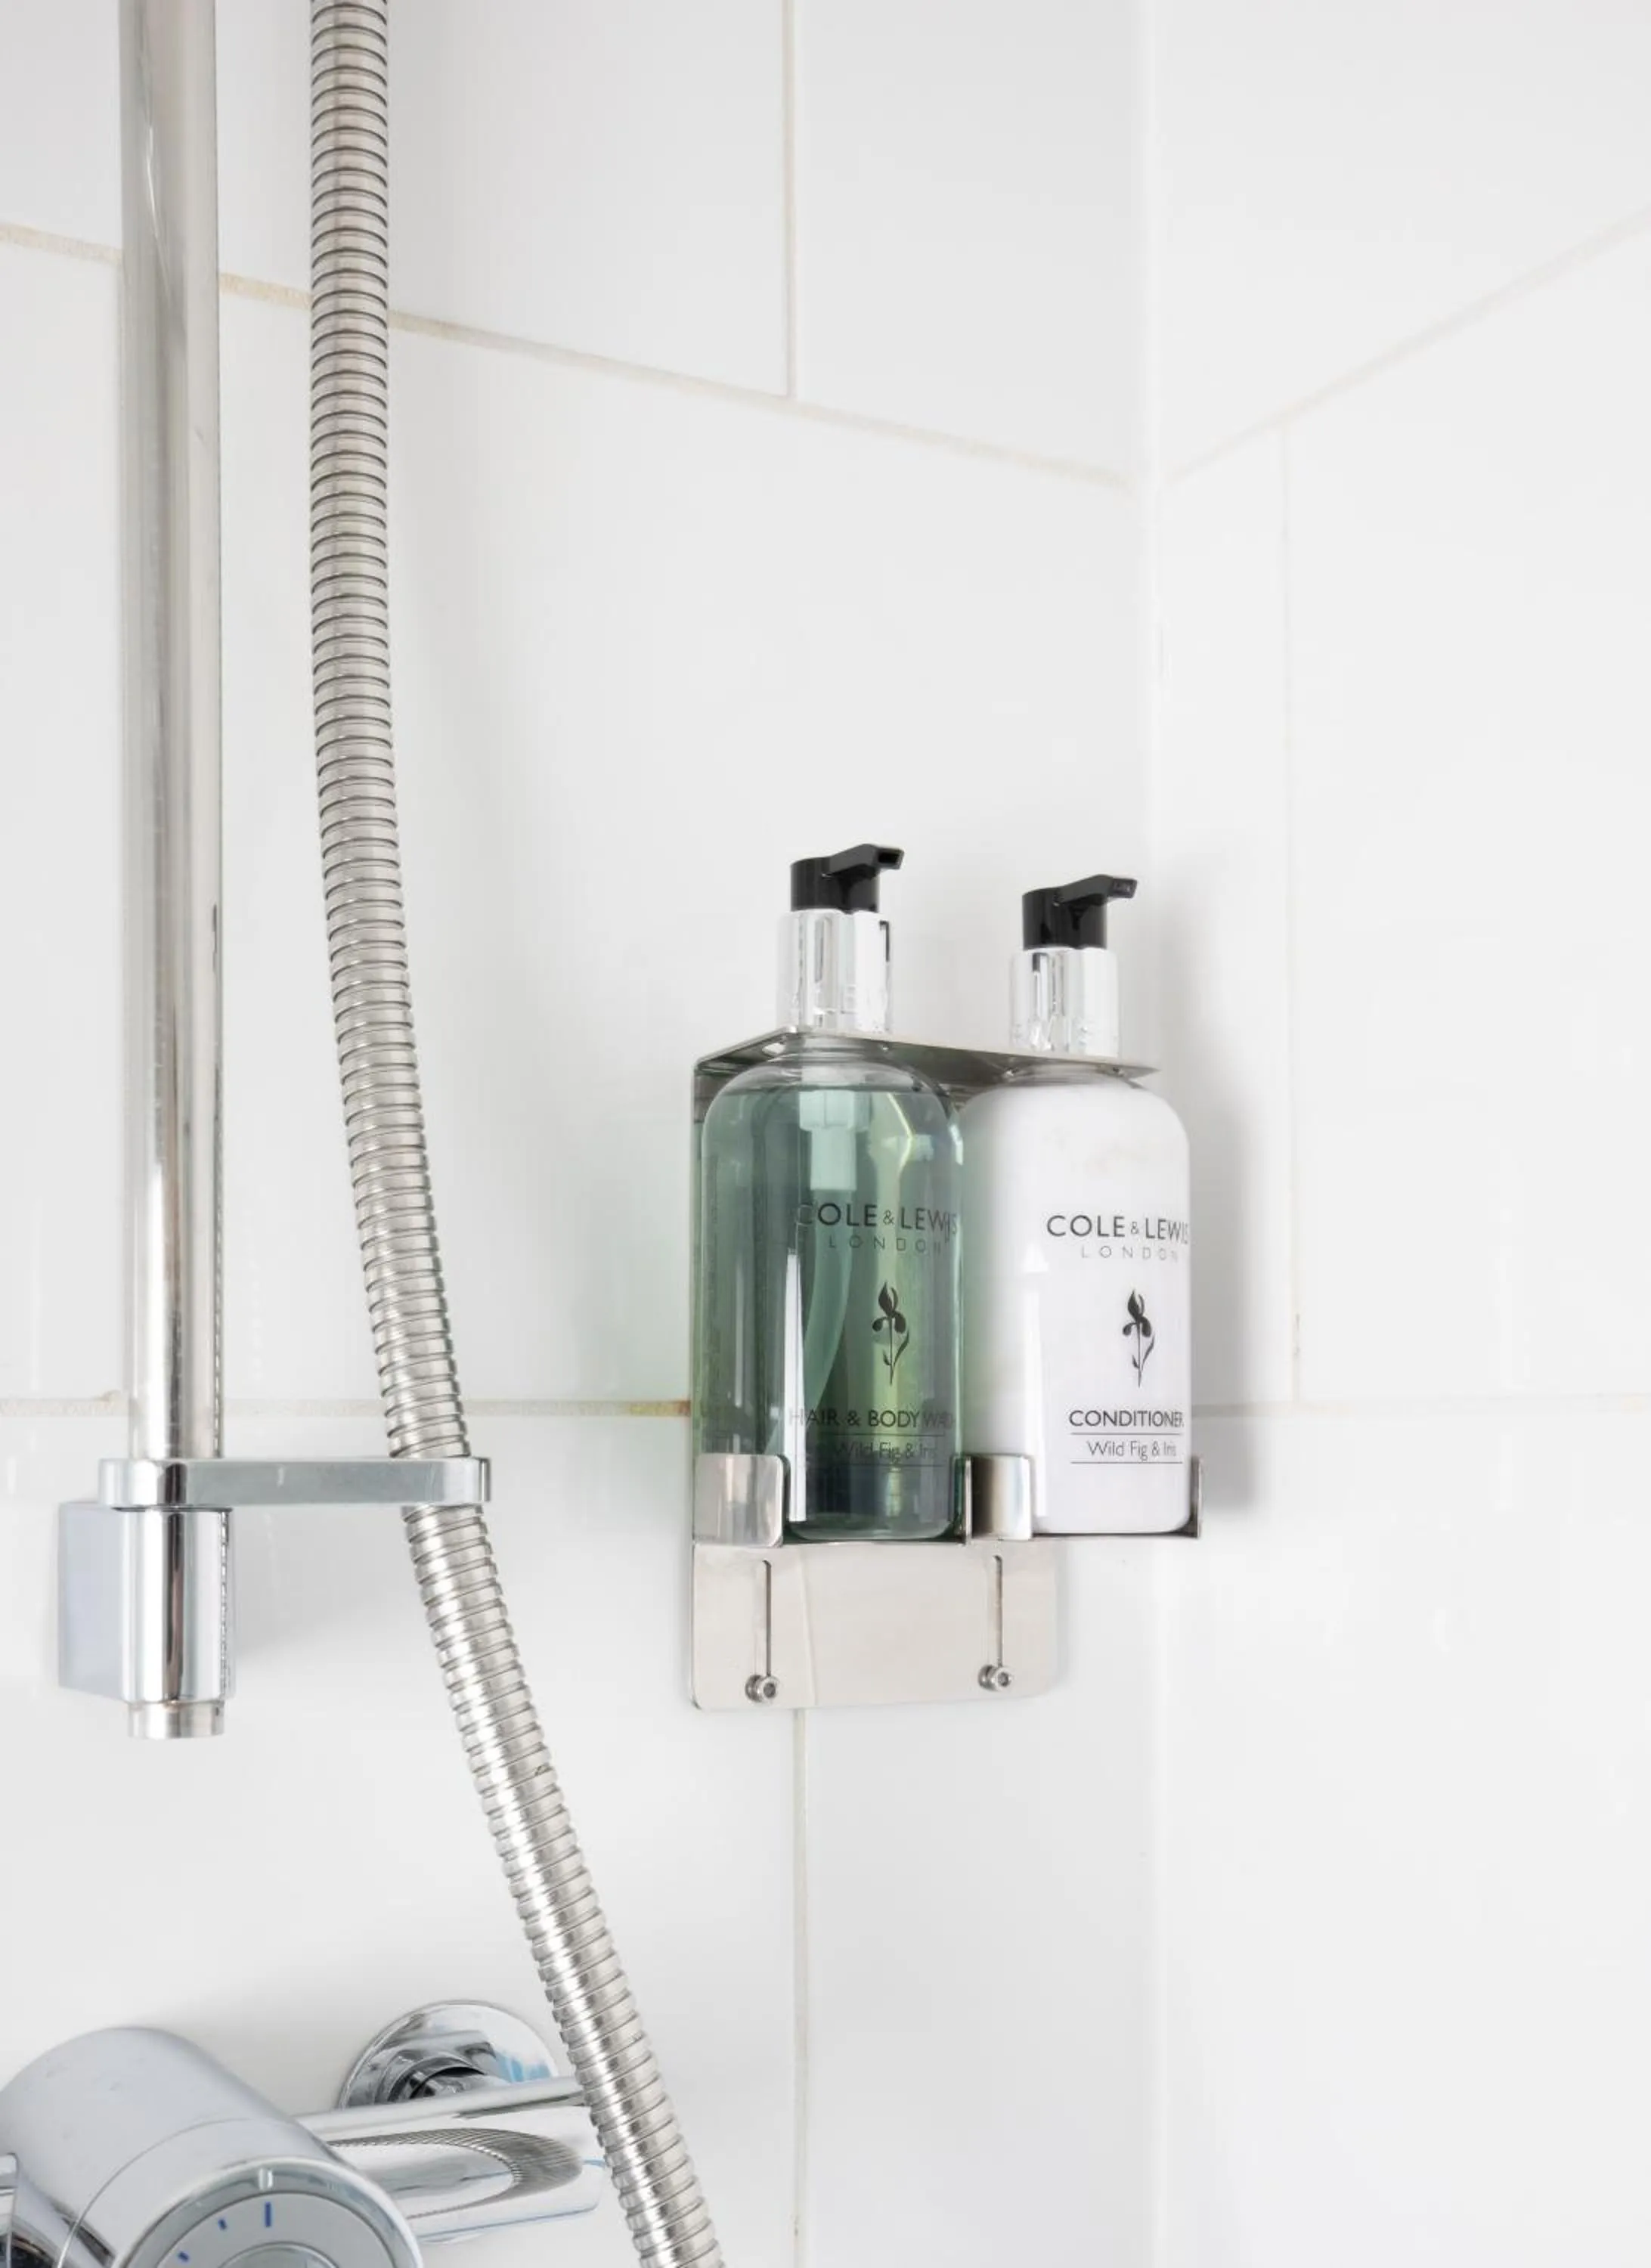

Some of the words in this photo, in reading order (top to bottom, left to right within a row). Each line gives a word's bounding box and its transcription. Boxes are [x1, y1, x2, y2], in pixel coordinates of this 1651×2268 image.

[1081, 1245, 1179, 1263] LONDON
[788, 1408, 841, 1427] HAIR
[847, 1410, 860, 1427] &
[868, 1409, 920, 1428] BODY
[835, 1439, 874, 1458] Wild
[879, 1441, 901, 1463] Fig
[906, 1442, 915, 1459] &
[1086, 1439, 1125, 1457] Wild
[1129, 1439, 1149, 1462] Fig
[1151, 1440, 1160, 1457] &
